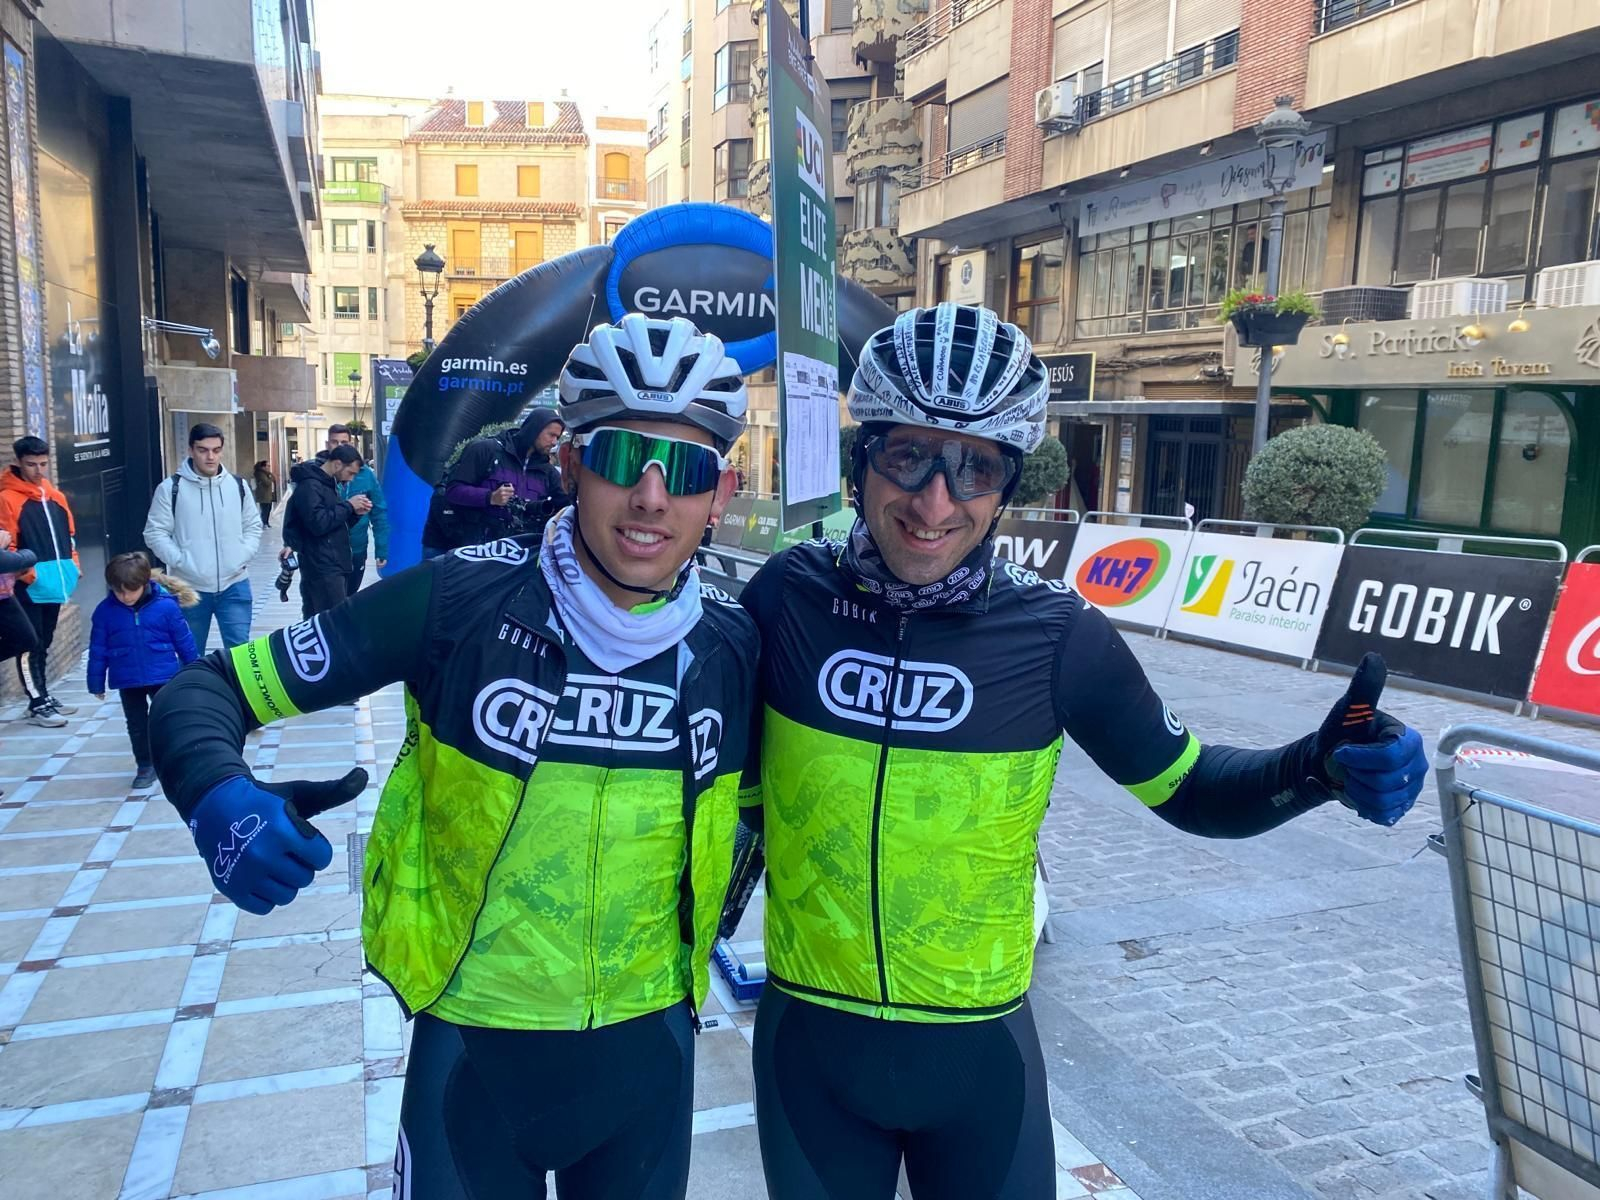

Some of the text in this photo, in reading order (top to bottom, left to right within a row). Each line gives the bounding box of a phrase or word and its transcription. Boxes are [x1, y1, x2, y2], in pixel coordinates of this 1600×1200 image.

[800, 121, 824, 188] UCI
[800, 191, 827, 262] ELITE
[634, 287, 776, 318] GARMIN
[800, 262, 828, 340] MEN
[67, 302, 83, 356] La
[1368, 326, 1469, 358] Patrick
[441, 356, 528, 376] garmin.es
[1447, 356, 1551, 378] Irish Tavern
[438, 375, 525, 397] garmin.pt
[642, 392, 669, 402] ABUS
[71, 369, 109, 435] Mafia
[938, 397, 966, 409] ABUS
[724, 513, 746, 527] GARMIN
[460, 540, 521, 560] CRUZ
[1233, 560, 1321, 616] Jaén
[833, 598, 877, 624] GOBIK
[1269, 614, 1312, 632] interior
[1349, 580, 1515, 655] GOBIK
[498, 624, 549, 659] GOBIK
[254, 670, 263, 682] IS
[831, 661, 955, 719] CRUZ
[551, 686, 674, 740] CRUZ
